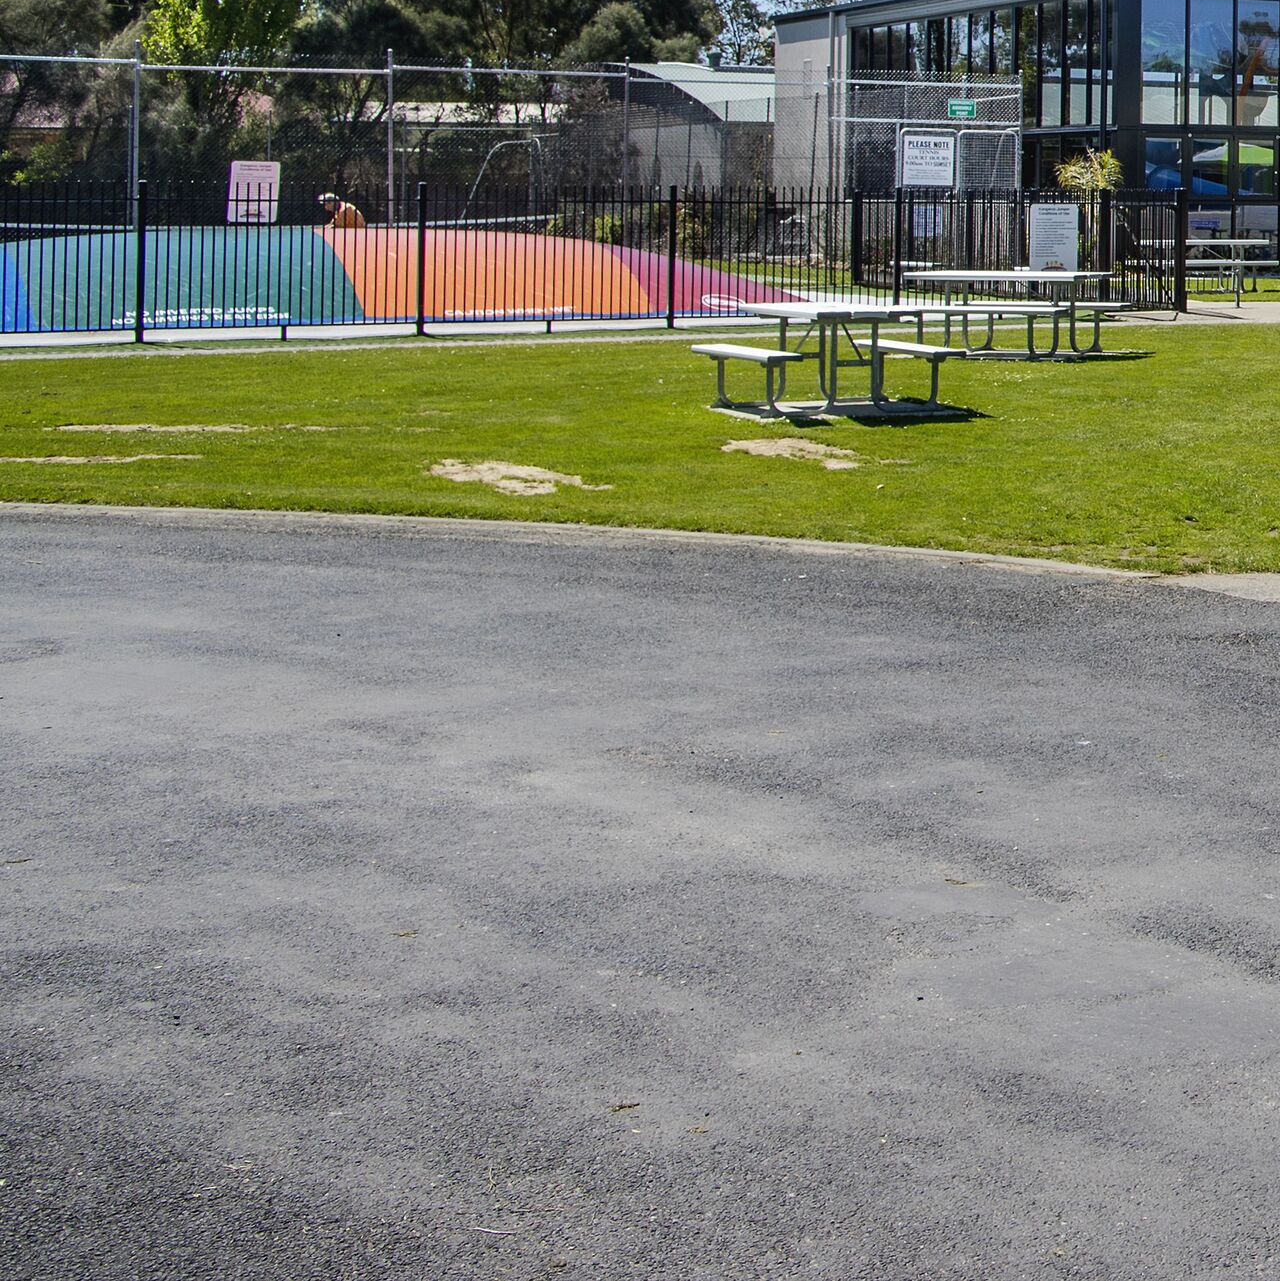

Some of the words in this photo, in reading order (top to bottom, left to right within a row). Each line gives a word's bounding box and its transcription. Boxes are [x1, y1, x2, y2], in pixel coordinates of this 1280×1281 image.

[908, 140, 931, 148] PLEASE
[933, 141, 949, 149] NOTE
[227, 306, 275, 314] JUMPS
[445, 308, 505, 316] CAUTION
[213, 313, 252, 321] NEAR
